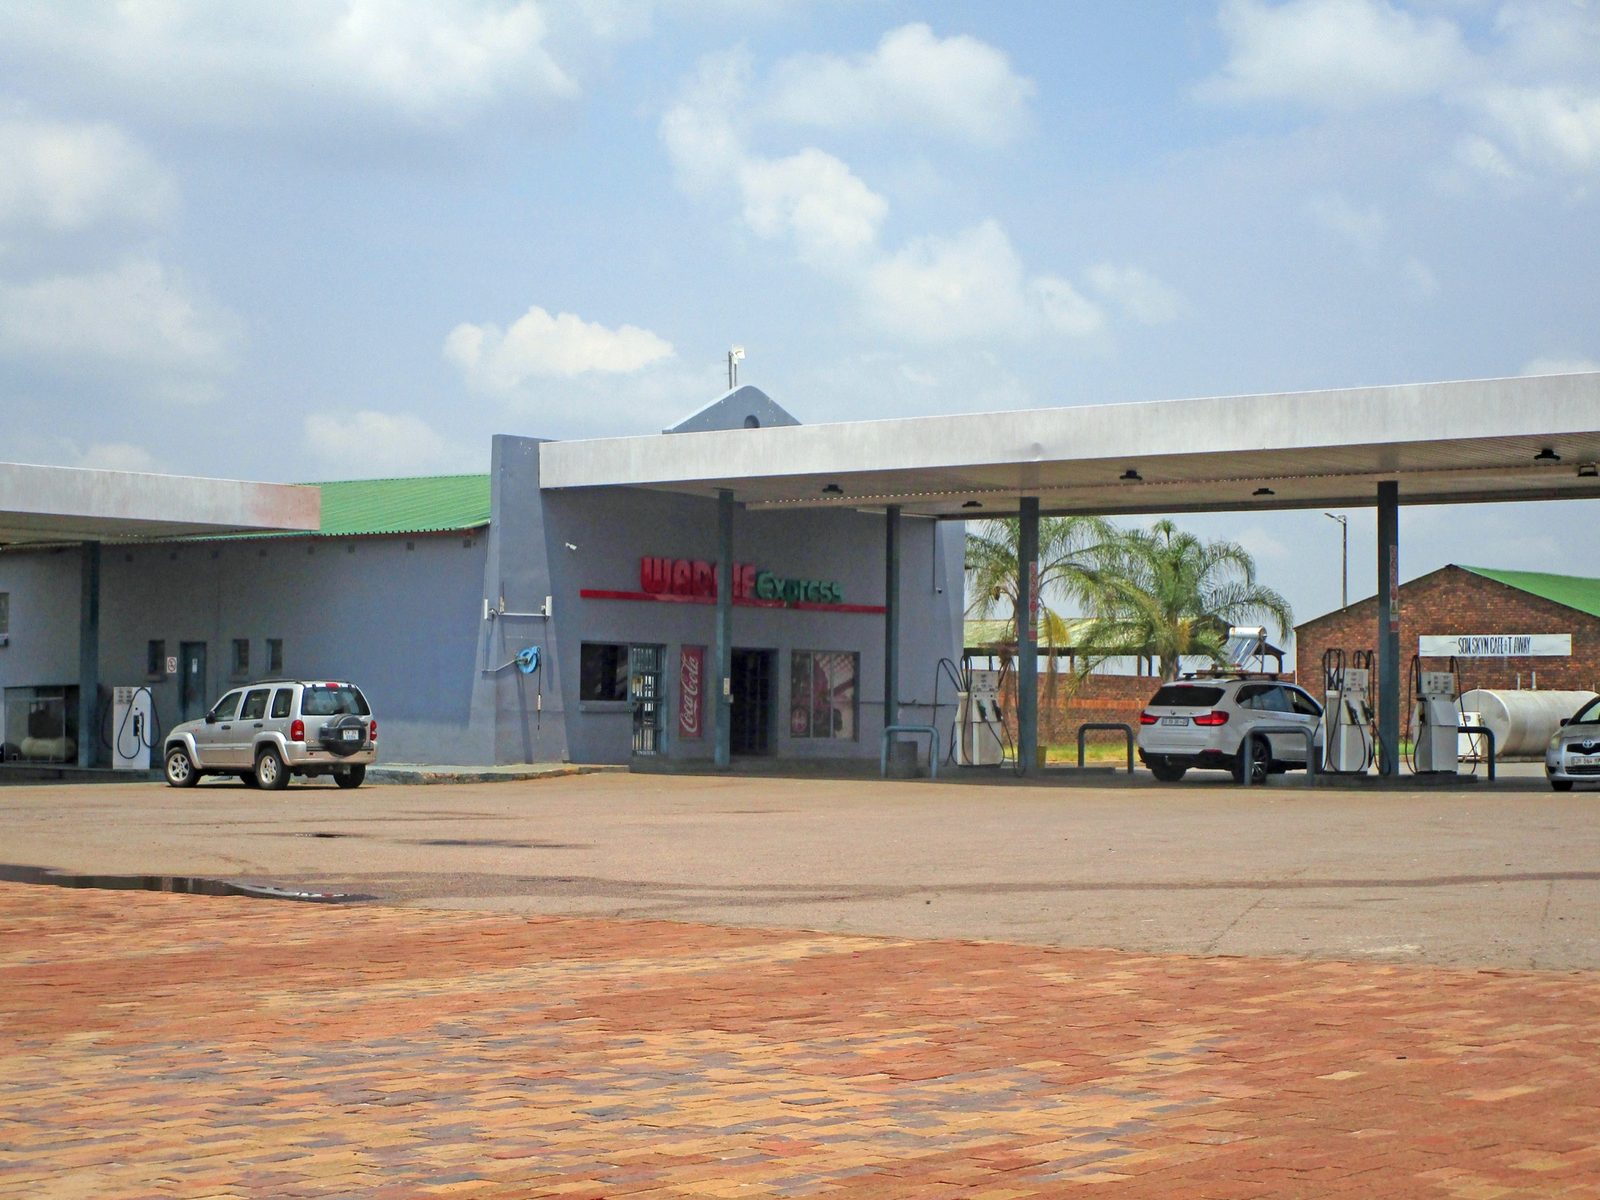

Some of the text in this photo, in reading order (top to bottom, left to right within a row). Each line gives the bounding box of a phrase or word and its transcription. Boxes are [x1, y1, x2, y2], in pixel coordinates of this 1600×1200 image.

[756, 571, 842, 605] Express
[1490, 637, 1503, 654] CAFE
[1514, 637, 1531, 654] AWAY
[680, 654, 699, 733] Coca-Cola
